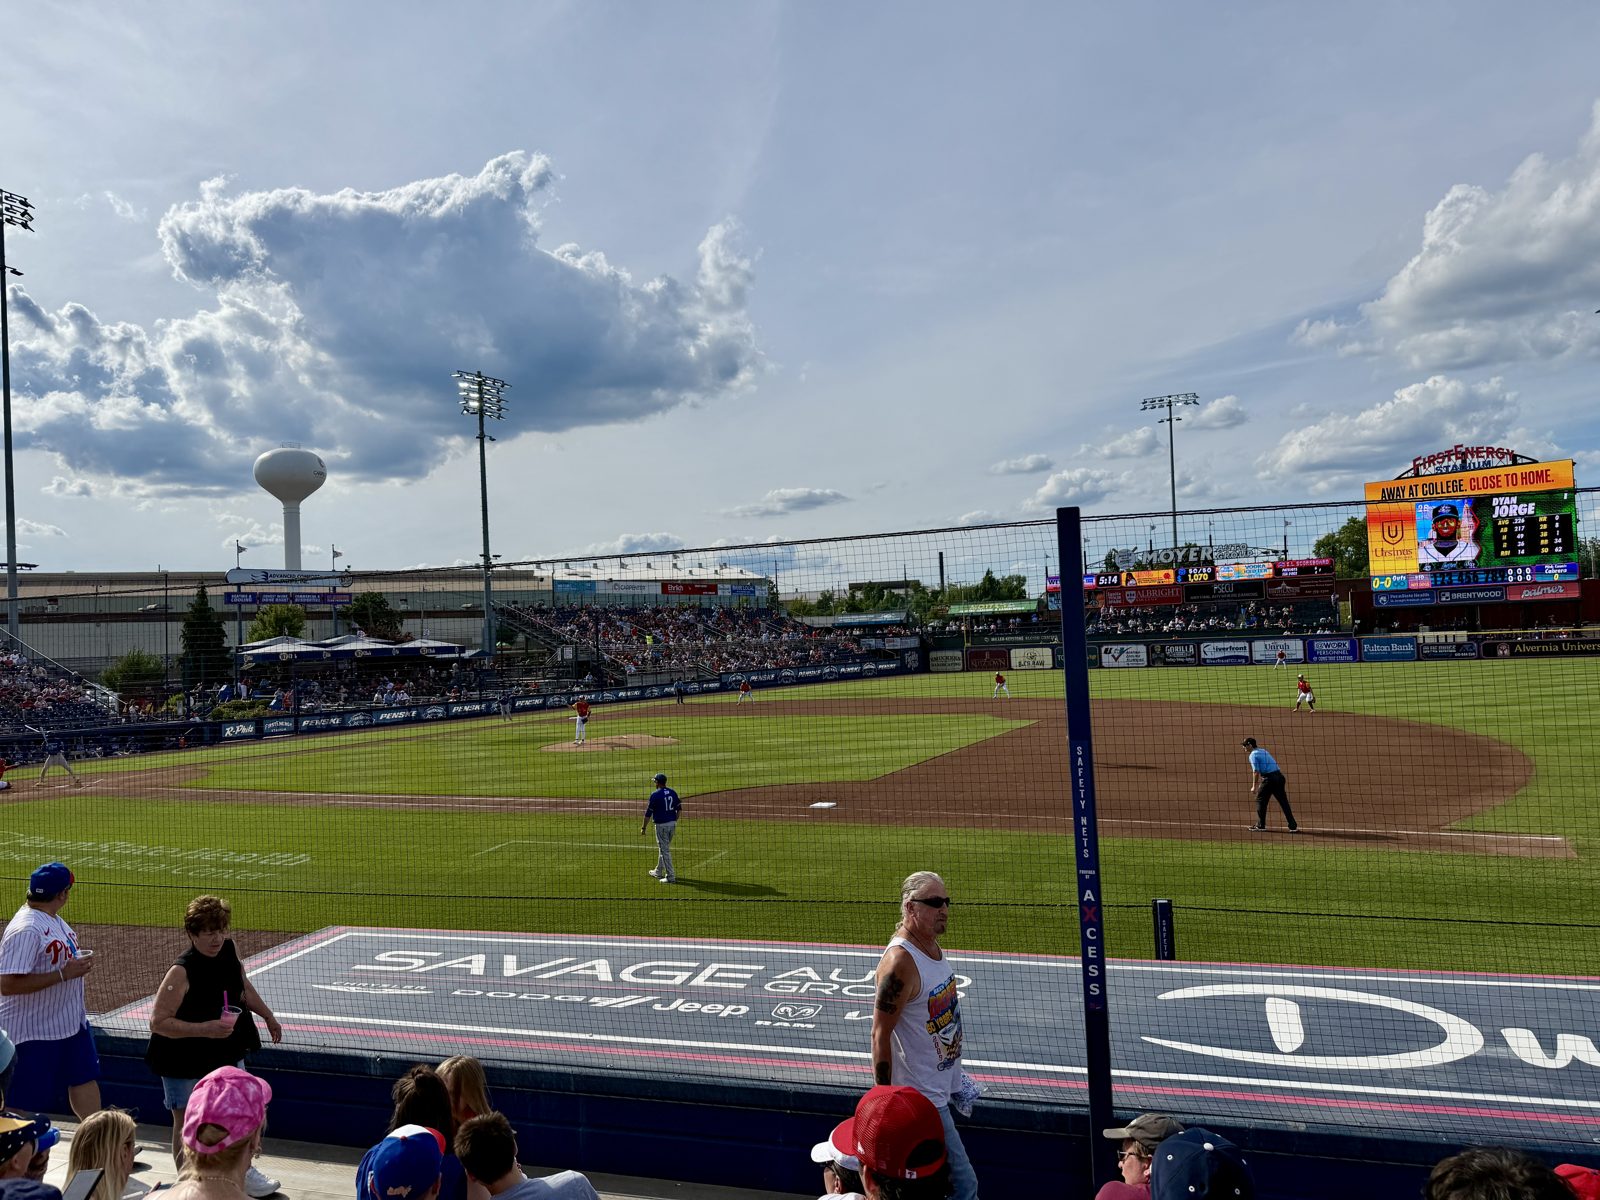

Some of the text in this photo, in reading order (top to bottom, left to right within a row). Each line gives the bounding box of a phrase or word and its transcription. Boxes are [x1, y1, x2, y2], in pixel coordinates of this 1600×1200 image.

[1435, 460, 1491, 474] STADIUM
[1381, 469, 1554, 500] AWAY AT COLLEGE. CLOSE TO HOME.
[1492, 496, 1517, 506] DYAN
[1492, 502, 1535, 518] JORGE
[1142, 546, 1213, 564] MOYER
[1375, 548, 1412, 557] Ursinus
[1187, 573, 1208, 582] 1,070
[1136, 588, 1180, 598] ALBRIGHT
[1214, 583, 1234, 593] PSECU
[1521, 584, 1564, 598] palmer
[1452, 590, 1501, 599] BRENTWOOD
[1165, 645, 1194, 654] GORILLA
[1364, 644, 1390, 653] Fulton
[1515, 643, 1559, 653] Alvernia
[750, 673, 775, 682] PENSKE
[515, 698, 544, 707] PENSKE
[452, 703, 485, 713] PENSKE
[379, 710, 417, 720] PENSKE
[302, 717, 343, 727] PENSKE
[225, 725, 254, 737] R-Phils
[1077, 746, 1086, 809] SAFETY
[664, 796, 674, 811] 12
[173, 864, 279, 881] Center
[1082, 890, 1100, 995] AXCESS
[352, 950, 765, 988] SAVAGE
[333, 981, 428, 990] CHRYSLER
[451, 989, 620, 1007] DODGE
[652, 998, 750, 1017] Jeep
[754, 1020, 816, 1029] RAM
